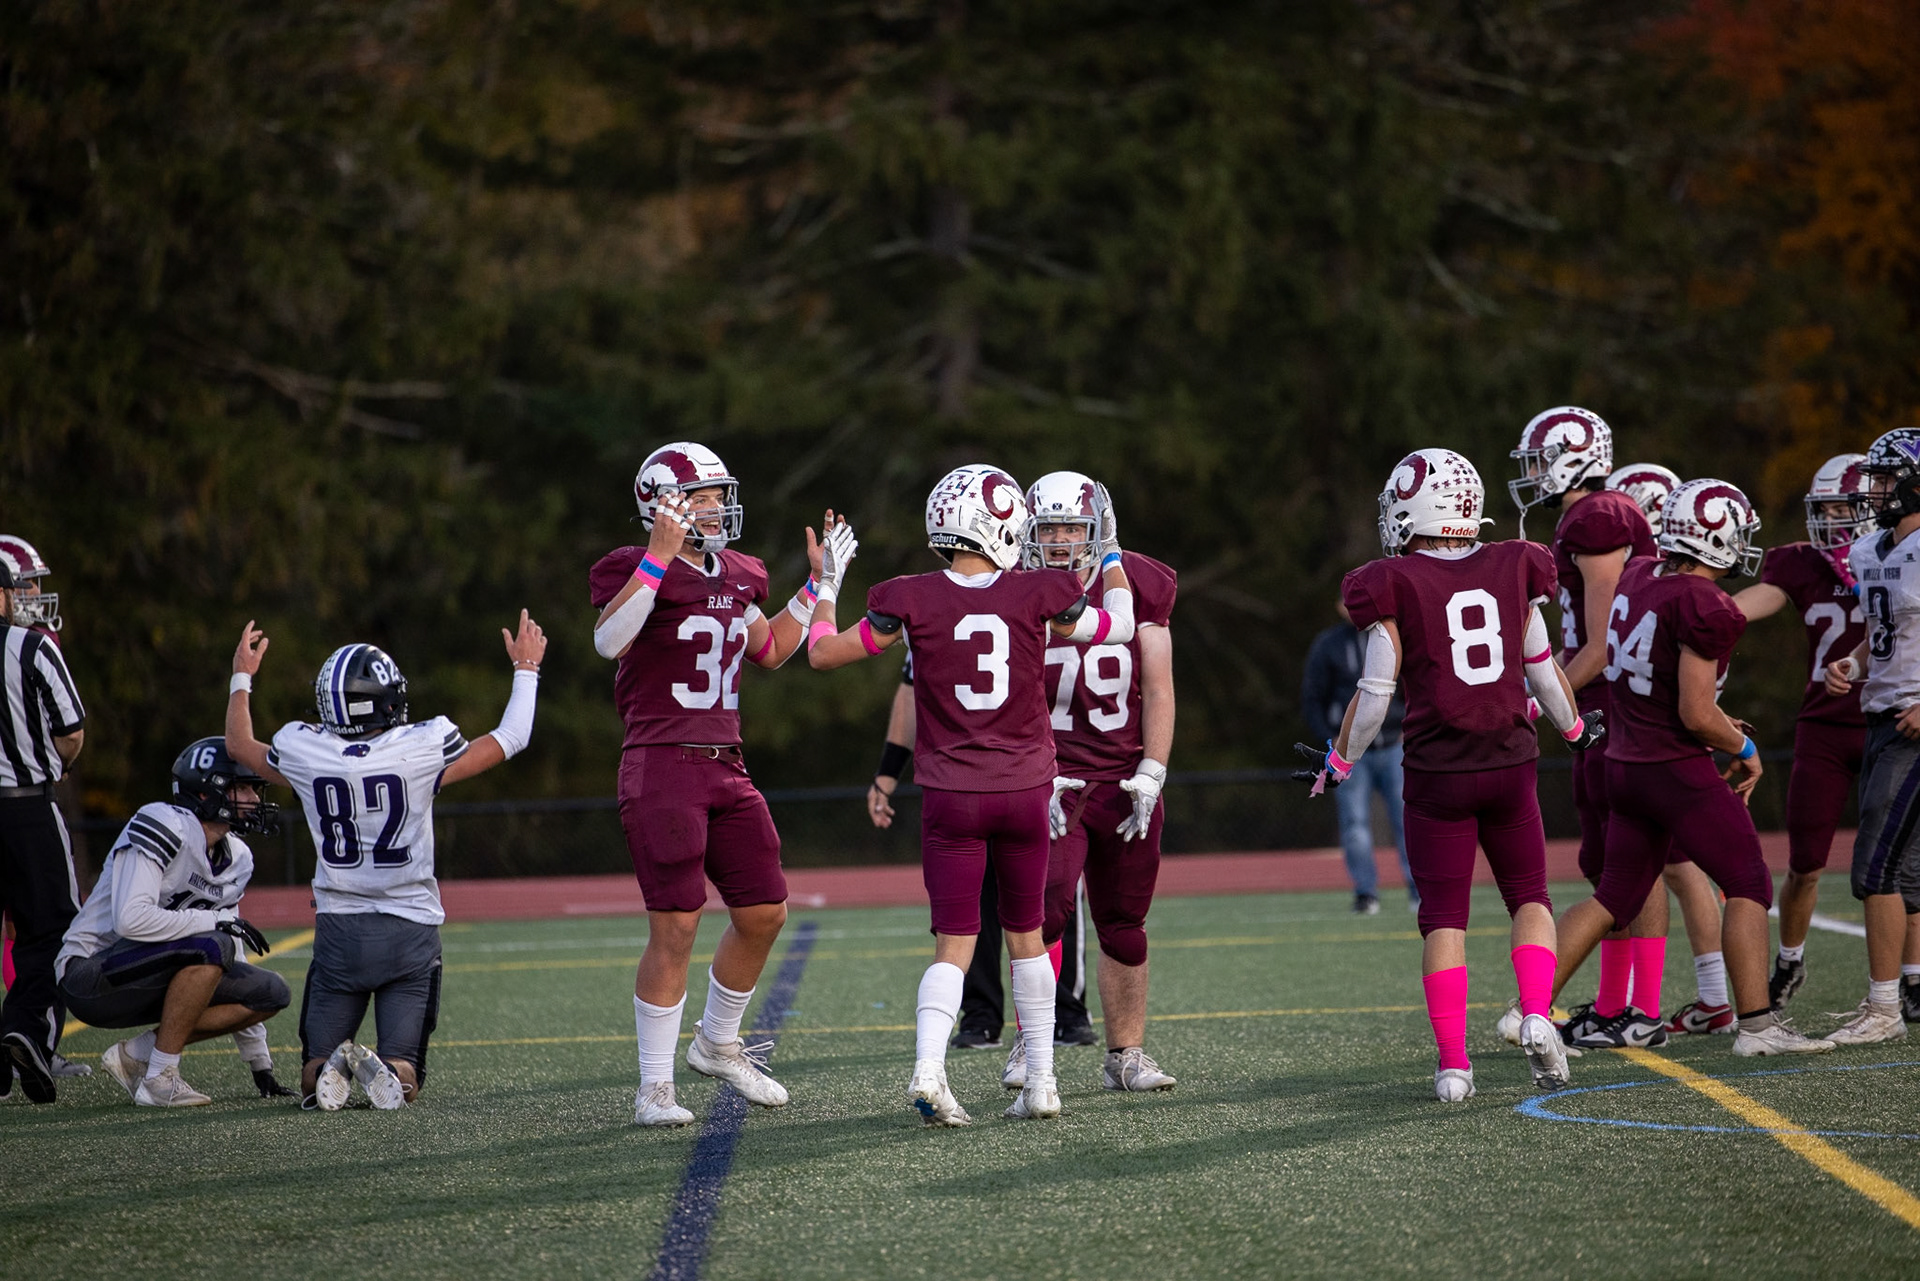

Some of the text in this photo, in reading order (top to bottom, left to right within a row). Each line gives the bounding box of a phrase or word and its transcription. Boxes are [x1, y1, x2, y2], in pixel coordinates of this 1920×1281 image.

[931, 533, 958, 544] schutt
[935, 507, 945, 527] 3
[1462, 498, 1472, 518] 8
[707, 595, 734, 609] RAMS
[1445, 588, 1505, 686] 8
[1868, 586, 1898, 661] 3
[371, 655, 401, 687] 82
[671, 615, 748, 710] 32
[954, 614, 1009, 710] 3
[1602, 593, 1658, 697] 64
[1804, 602, 1865, 682] 2
[1044, 643, 1133, 732] 79
[189, 746, 217, 770] 16
[312, 773, 413, 869] 82
